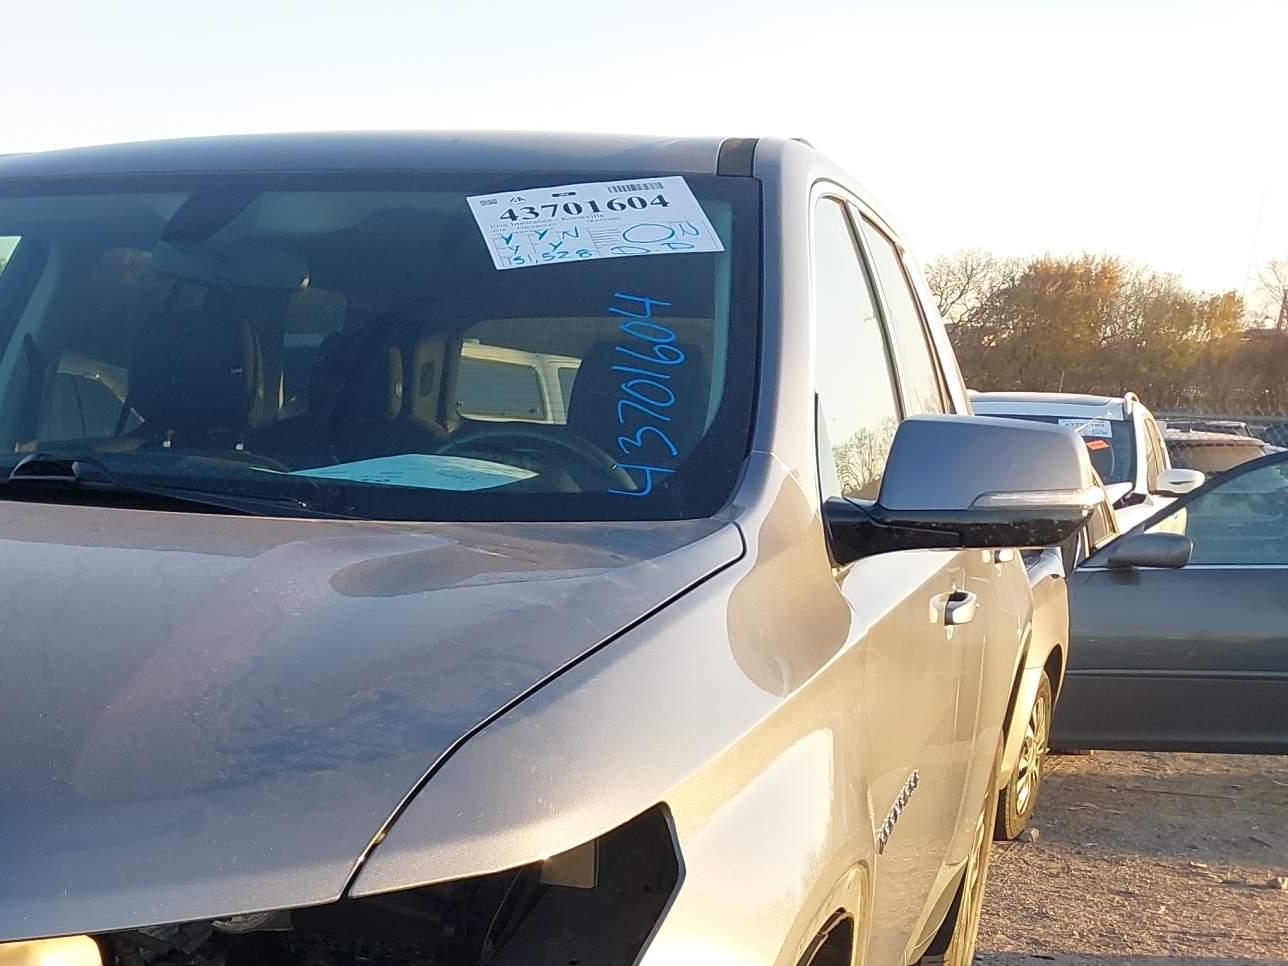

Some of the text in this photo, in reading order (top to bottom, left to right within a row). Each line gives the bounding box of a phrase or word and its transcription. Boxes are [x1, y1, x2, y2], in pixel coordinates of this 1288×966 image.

[499, 194, 670, 222] 43701604
[510, 218, 553, 228] Insurance
[561, 212, 605, 222] Knoxville
[608, 292, 686, 497] 43701604
